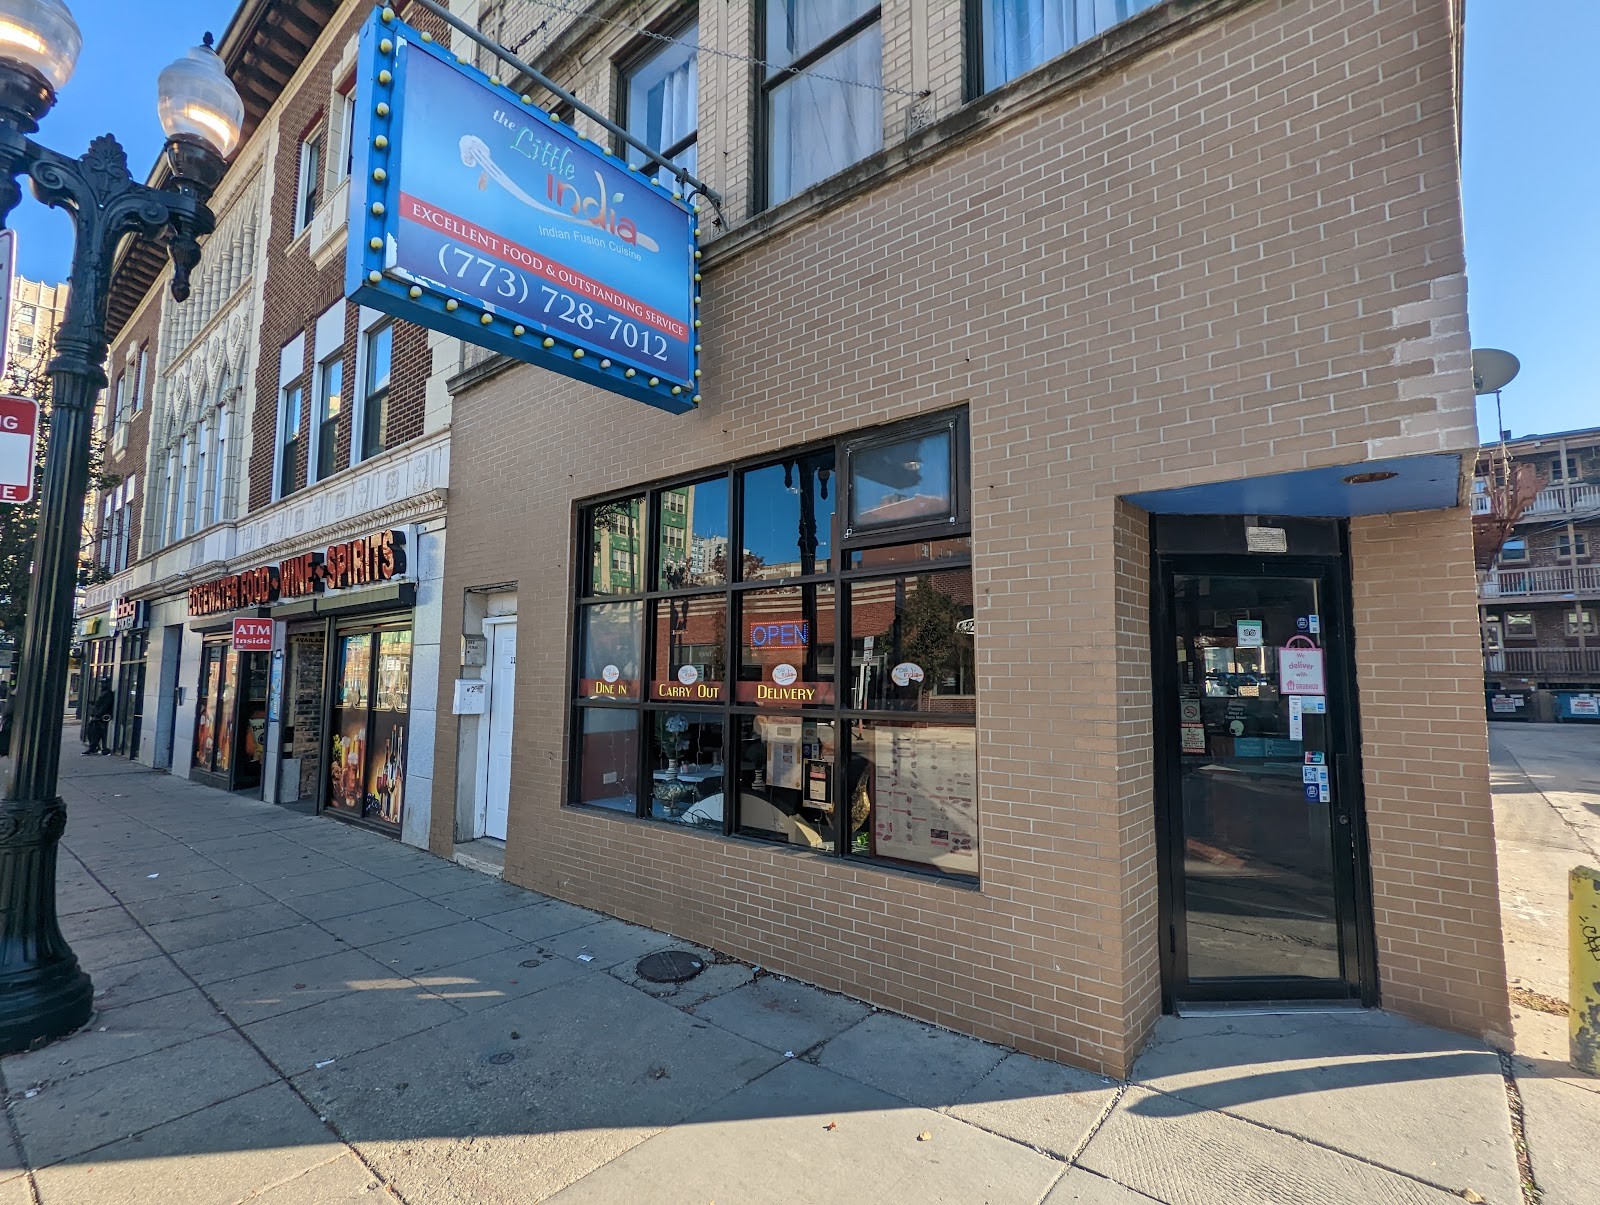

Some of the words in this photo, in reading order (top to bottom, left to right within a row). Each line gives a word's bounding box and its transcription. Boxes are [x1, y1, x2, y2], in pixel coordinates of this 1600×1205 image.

[492, 109, 516, 131] the
[510, 126, 575, 180] Little
[547, 170, 637, 246] India
[538, 225, 571, 241] Indian
[573, 232, 606, 249] Fusion
[609, 241, 642, 262] Cuisine
[412, 203, 499, 250] EXCELLENT
[503, 243, 543, 271] FOOD
[546, 264, 557, 278] &
[558, 270, 643, 317] OUTSTANDING
[645, 309, 684, 336] SERVICE
[438, 243, 529, 303] (773)
[541, 285, 668, 361] 728-7012
[188, 575, 239, 617] EDGEWATER
[241, 566, 270, 607] FOOD
[279, 552, 315, 598] WINE
[327, 529, 395, 590] SPIRITS
[235, 637, 270, 645] Inside
[236, 624, 271, 636] ATM
[752, 624, 808, 647] OPEN
[1289, 661, 1314, 670] deliver
